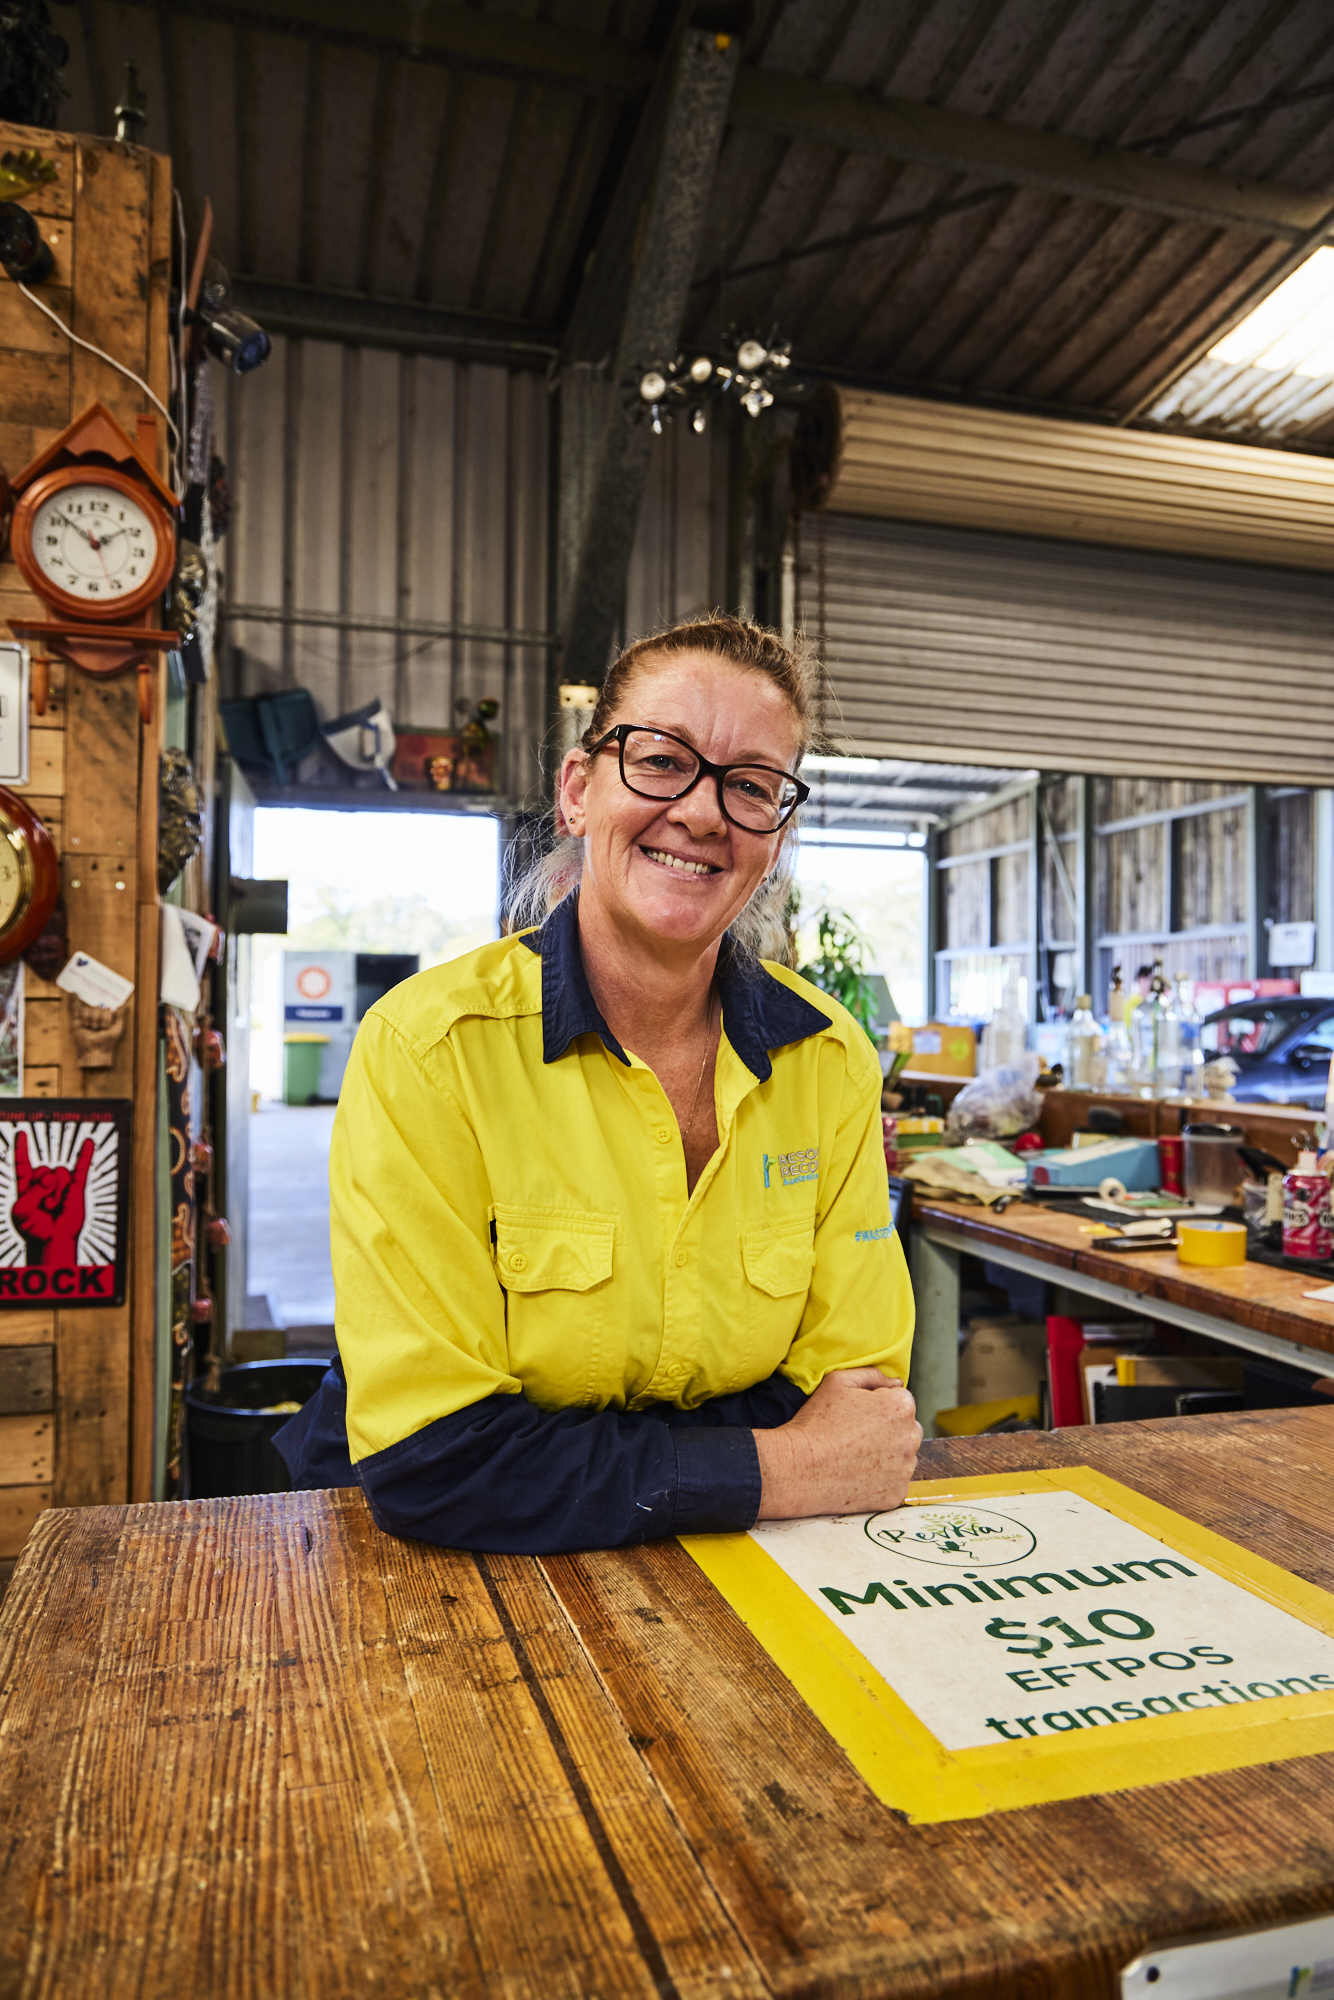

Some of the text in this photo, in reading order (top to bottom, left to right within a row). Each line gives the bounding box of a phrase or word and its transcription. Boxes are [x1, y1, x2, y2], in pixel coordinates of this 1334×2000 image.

[68, 503, 83, 514] 11
[90, 501, 109, 513] 12
[119, 511, 125, 521] 1
[780, 1159, 818, 1178] RECO
[0, 1268, 105, 1296] ROCK
[968, 1533, 1023, 1543] AUSTRALIA
[818, 1558, 1199, 1616] Minimum
[984, 1608, 1155, 1659] $10
[1005, 1645, 1234, 1692] EFTPOS
[985, 1673, 1334, 1740] transactions
